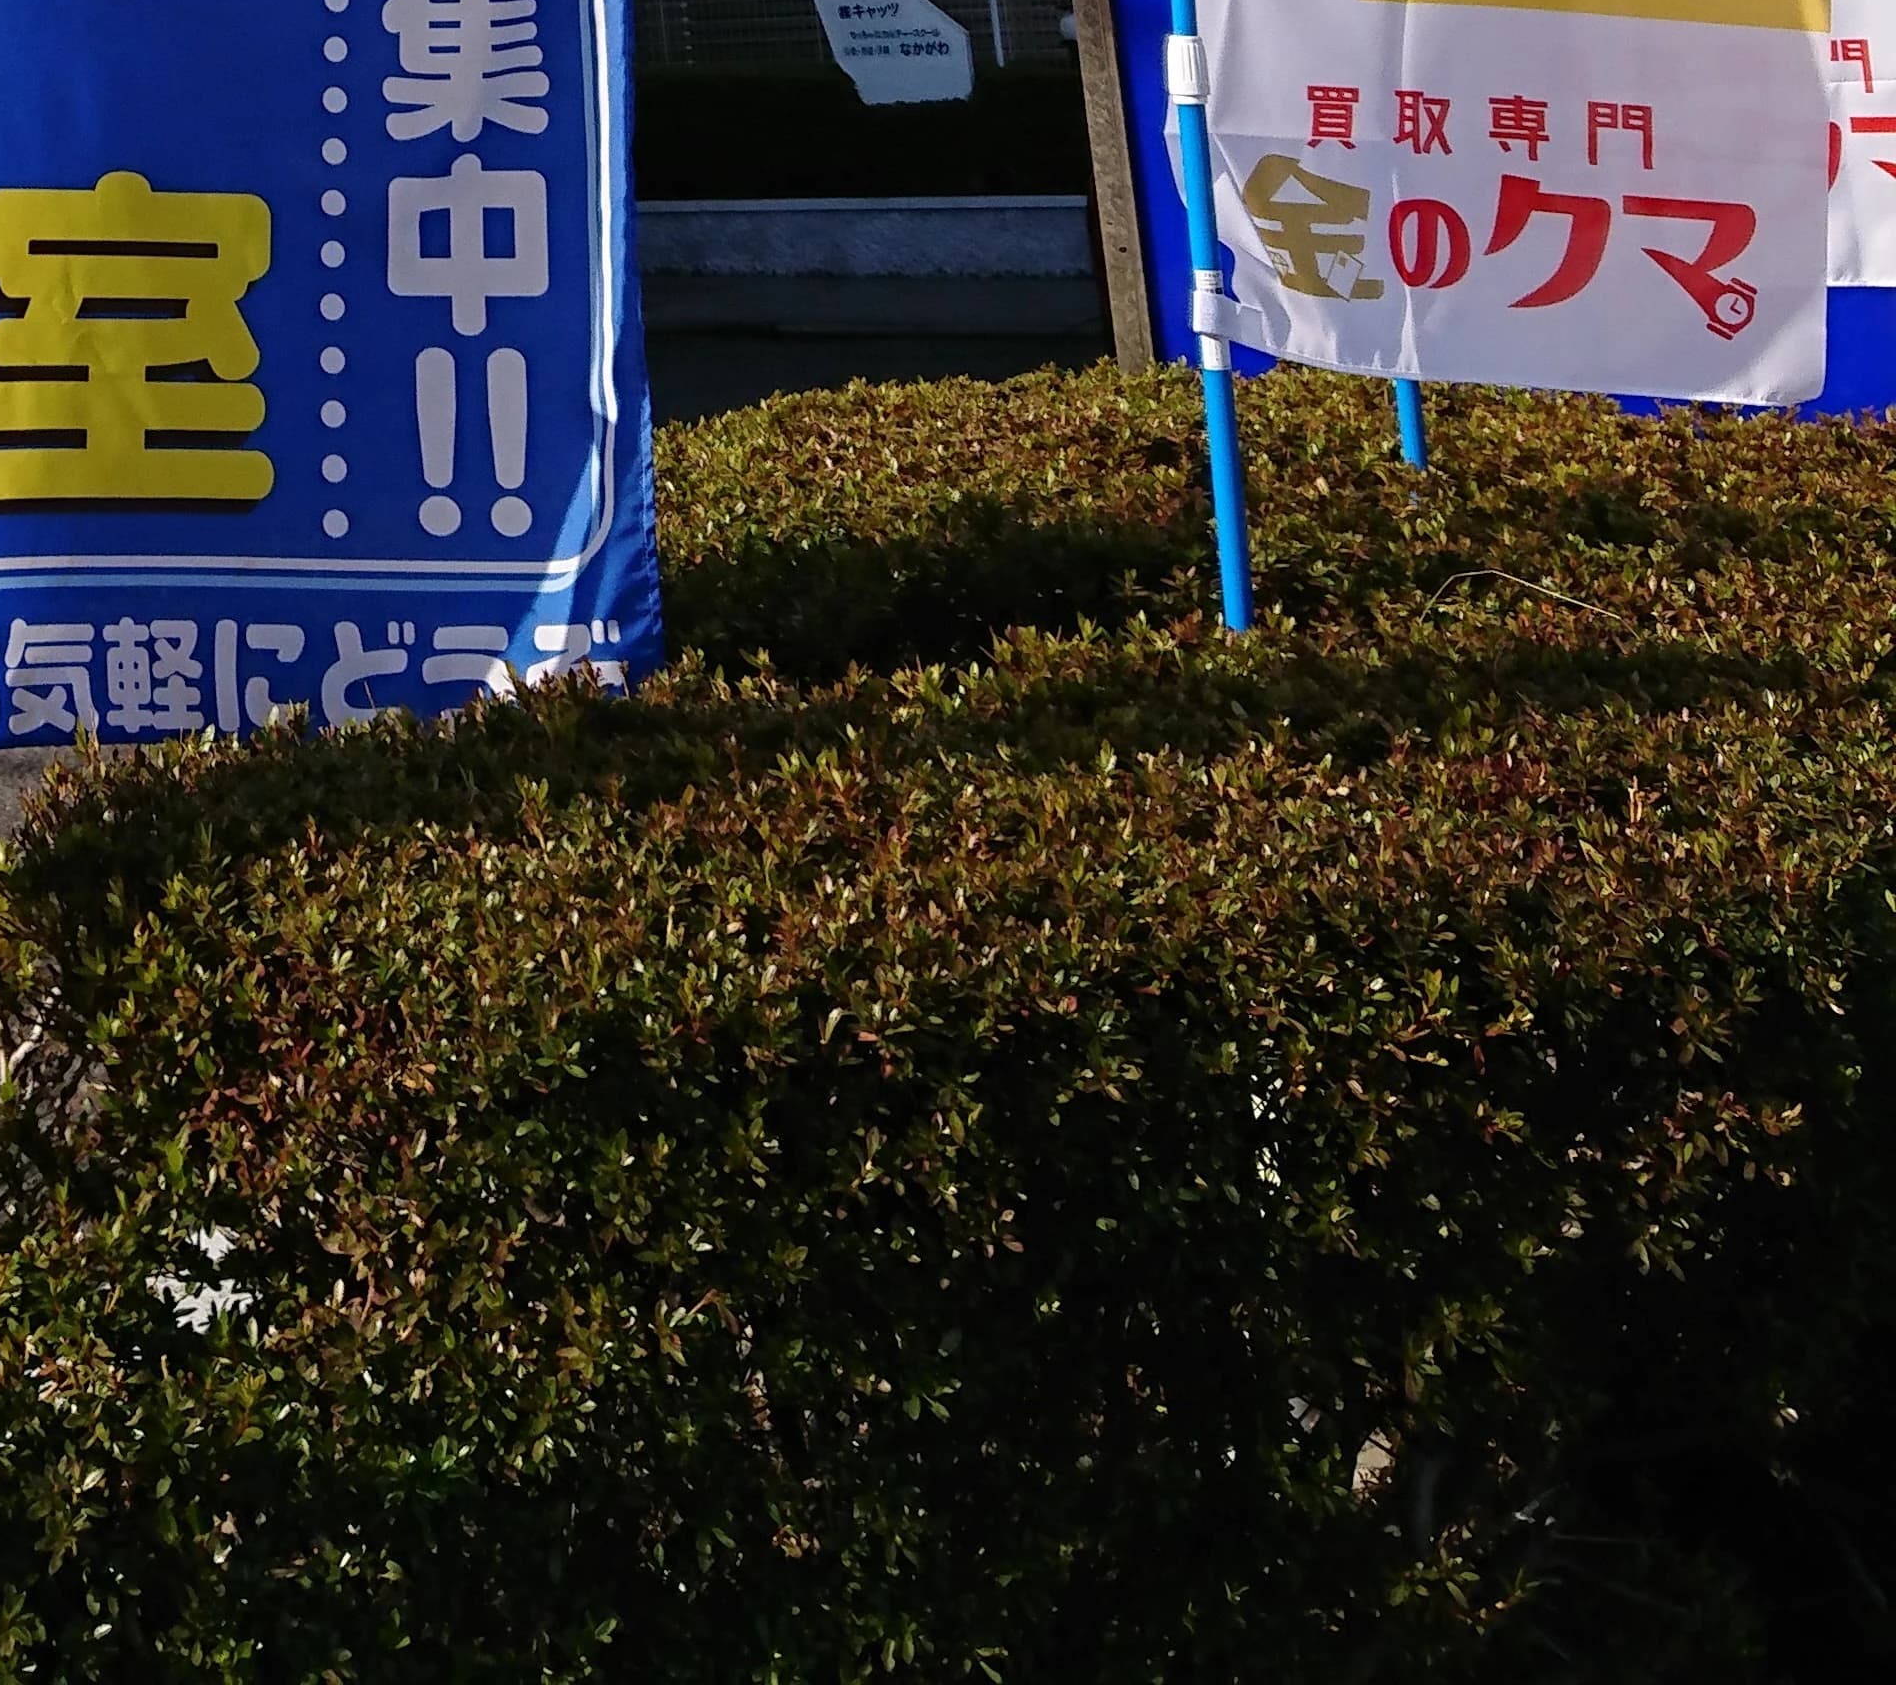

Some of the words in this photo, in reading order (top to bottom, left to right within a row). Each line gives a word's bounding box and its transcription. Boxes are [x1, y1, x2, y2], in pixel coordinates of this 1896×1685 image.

[899, 41, 950, 57] なかがわ
[1307, 85, 1654, 170] 買取専門
[1242, 153, 1757, 340] 金のクマ
